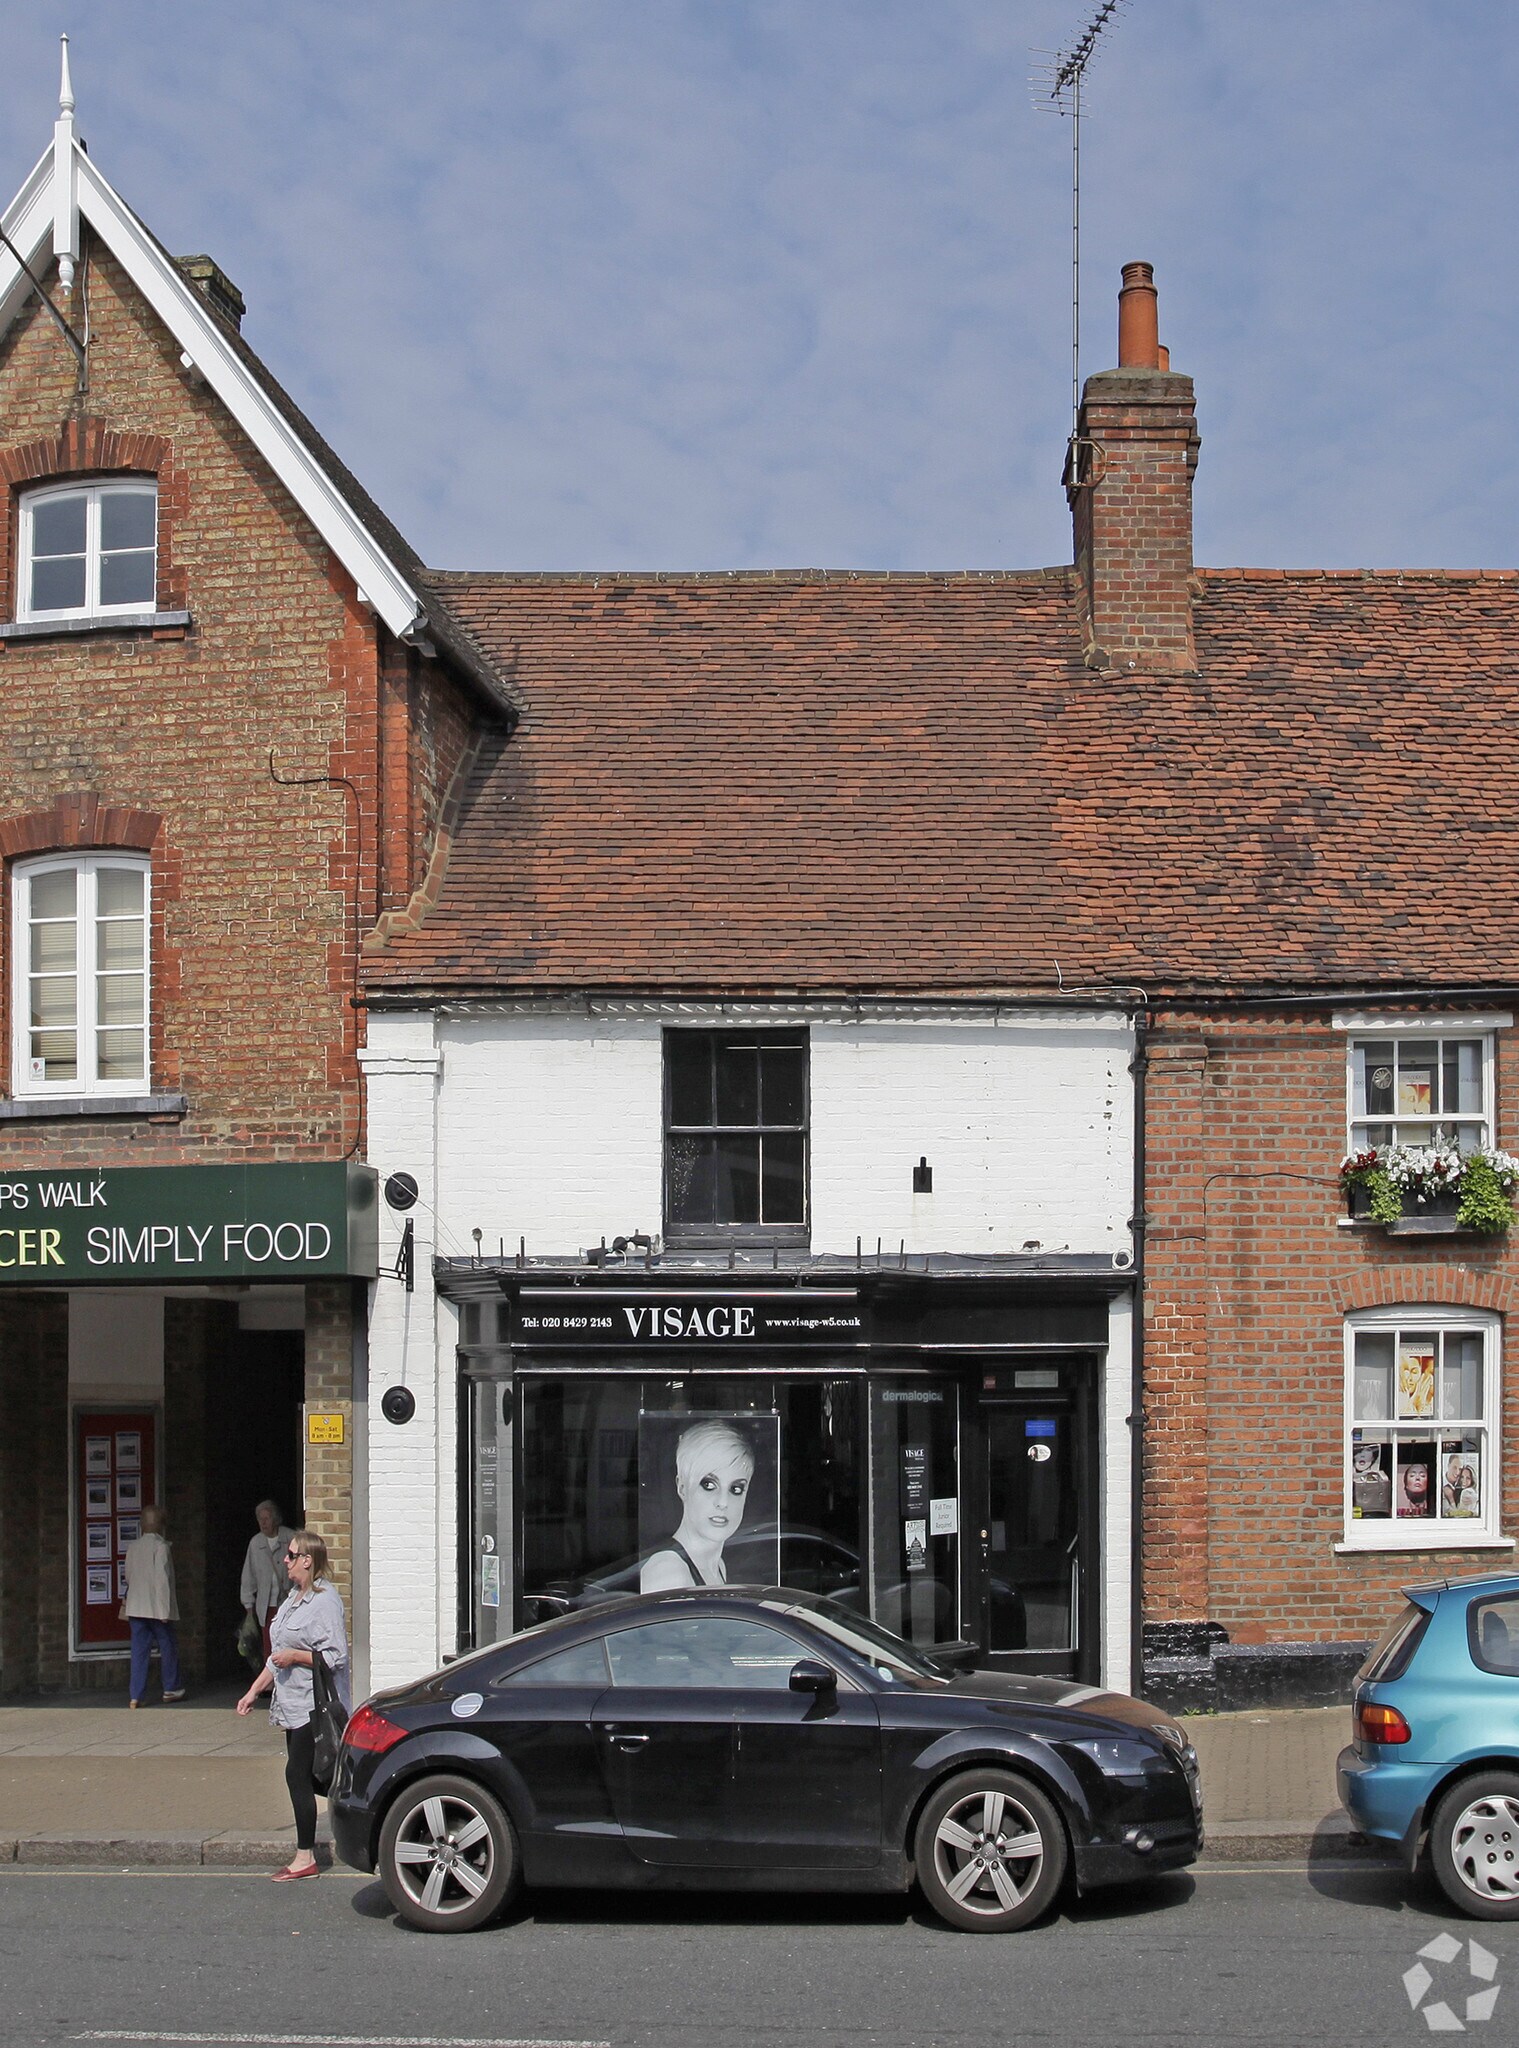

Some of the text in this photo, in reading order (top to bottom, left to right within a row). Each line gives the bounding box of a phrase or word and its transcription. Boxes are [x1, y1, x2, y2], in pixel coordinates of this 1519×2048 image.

[0, 1181, 108, 1209] PS WALK
[0, 1222, 332, 1267] CER SIMPLY FOOD
[521, 1307, 861, 1338] Tel: 020 8429 2143 VISAGE www.visage-w5.co.uk
[882, 1390, 943, 1403] dermalogica
